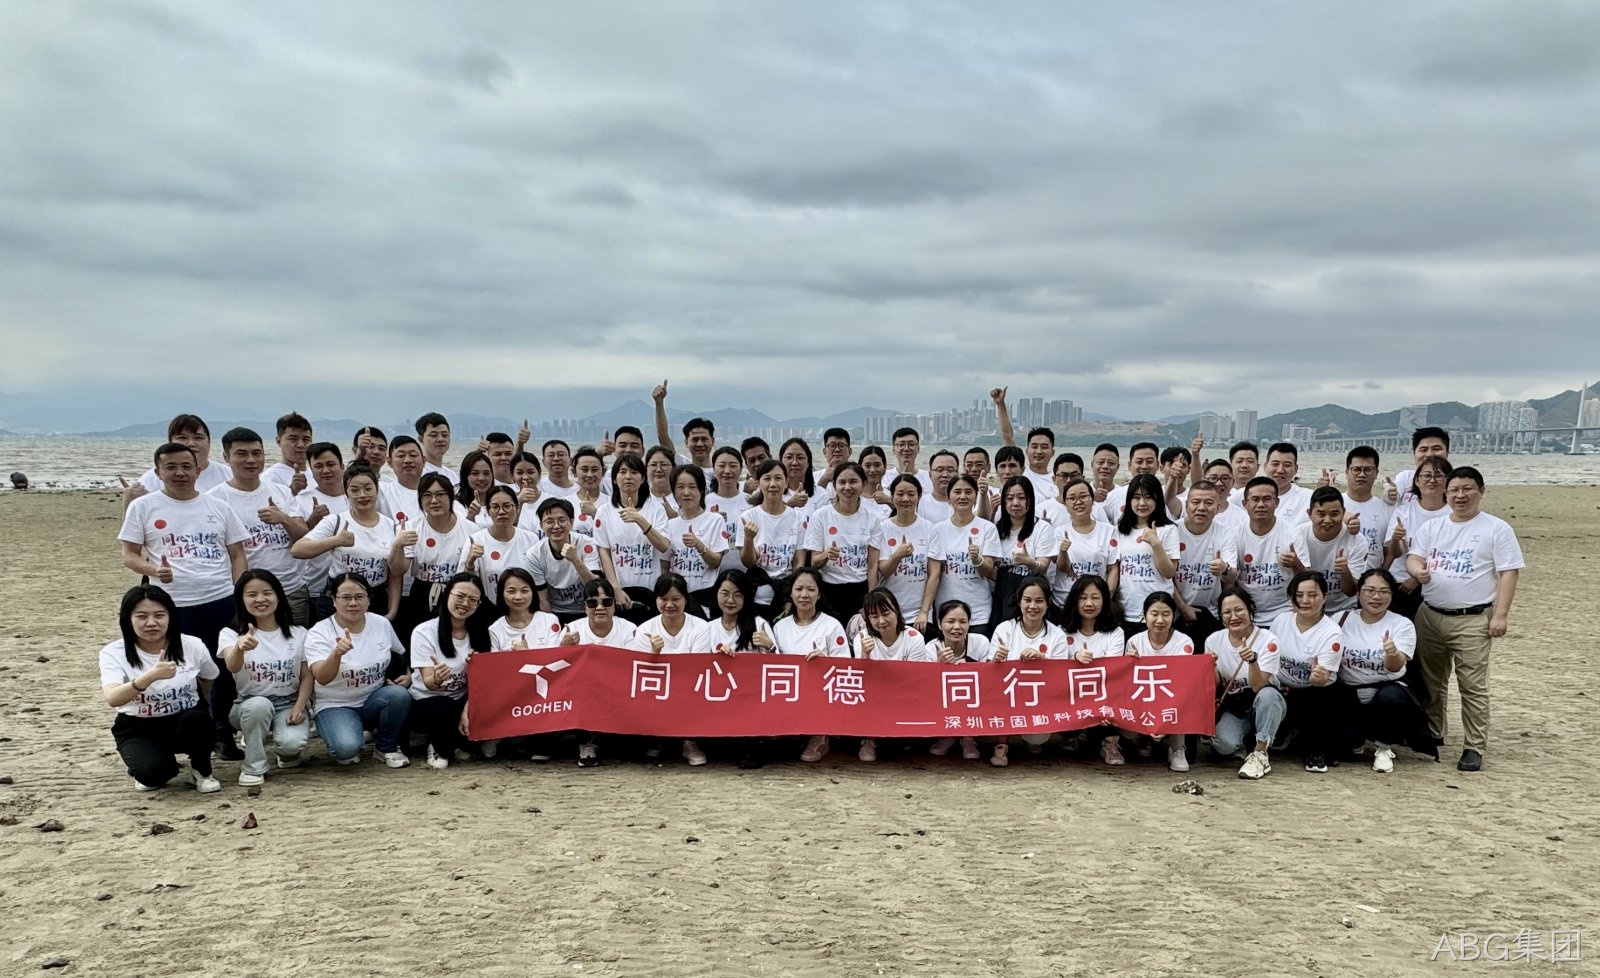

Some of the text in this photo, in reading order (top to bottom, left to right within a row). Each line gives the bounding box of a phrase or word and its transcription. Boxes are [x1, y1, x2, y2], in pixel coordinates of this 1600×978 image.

[629, 659, 1175, 709] 同心同德 同行同乐
[511, 700, 573, 718] GOCHEN
